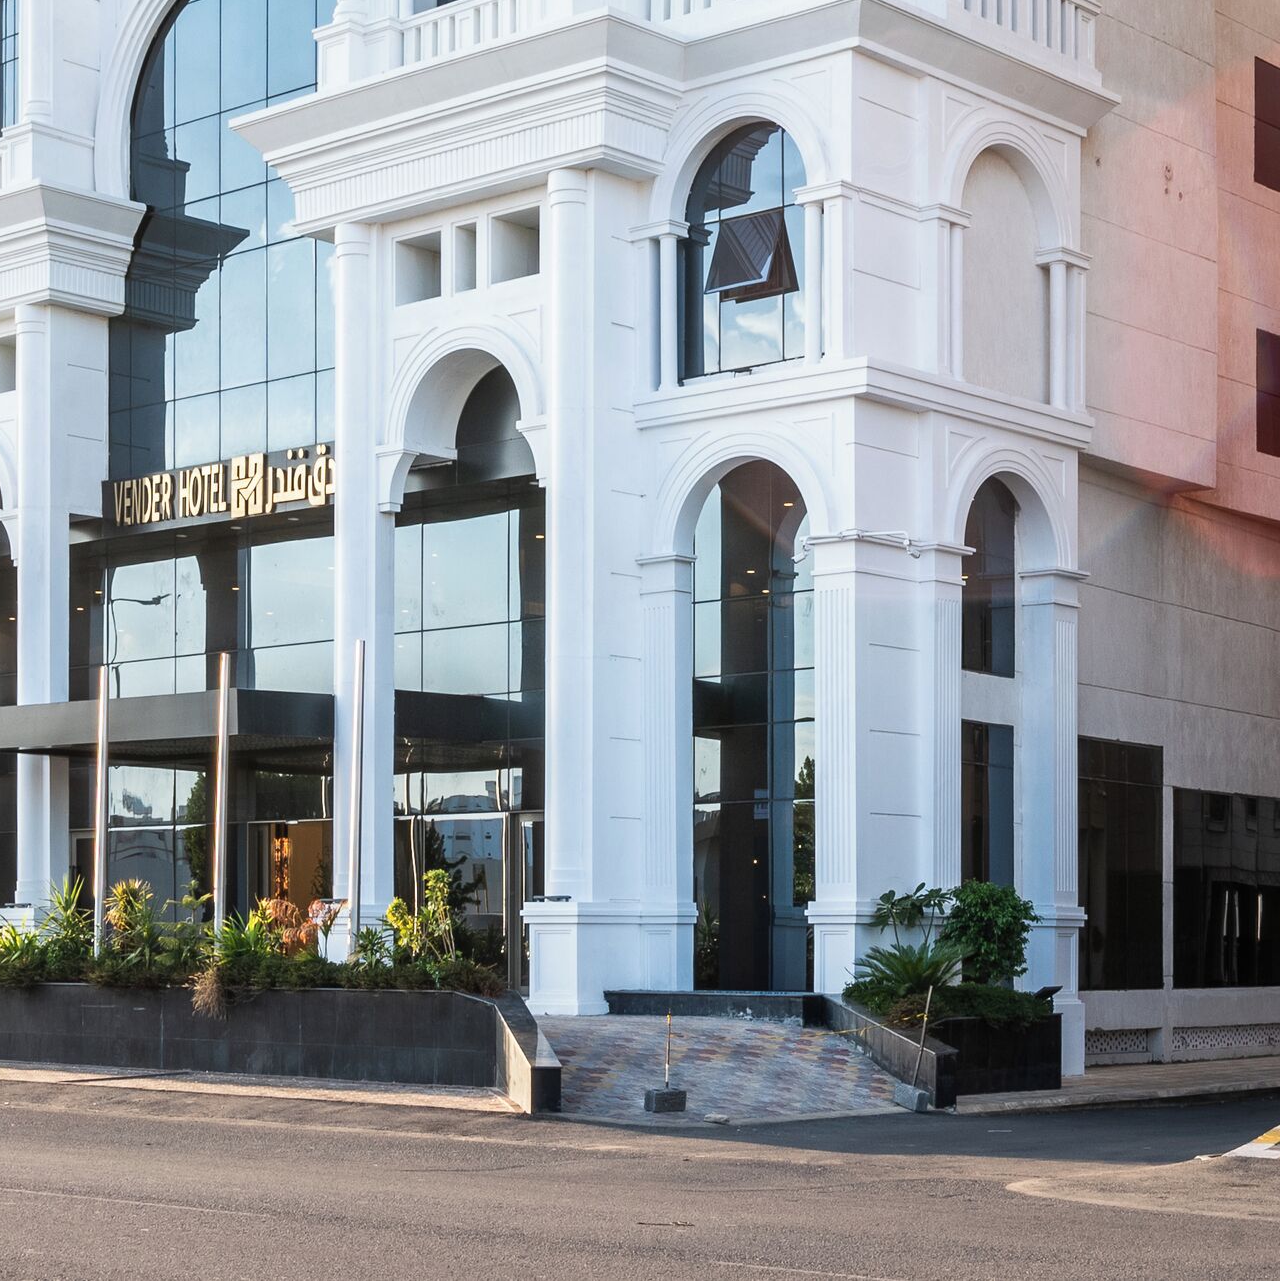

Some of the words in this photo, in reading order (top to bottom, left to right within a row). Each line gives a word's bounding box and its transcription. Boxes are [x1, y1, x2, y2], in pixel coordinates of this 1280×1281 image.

[113, 473, 173, 527] VENDER
[179, 463, 227, 518] HOTEL
[307, 444, 336, 506] دق
